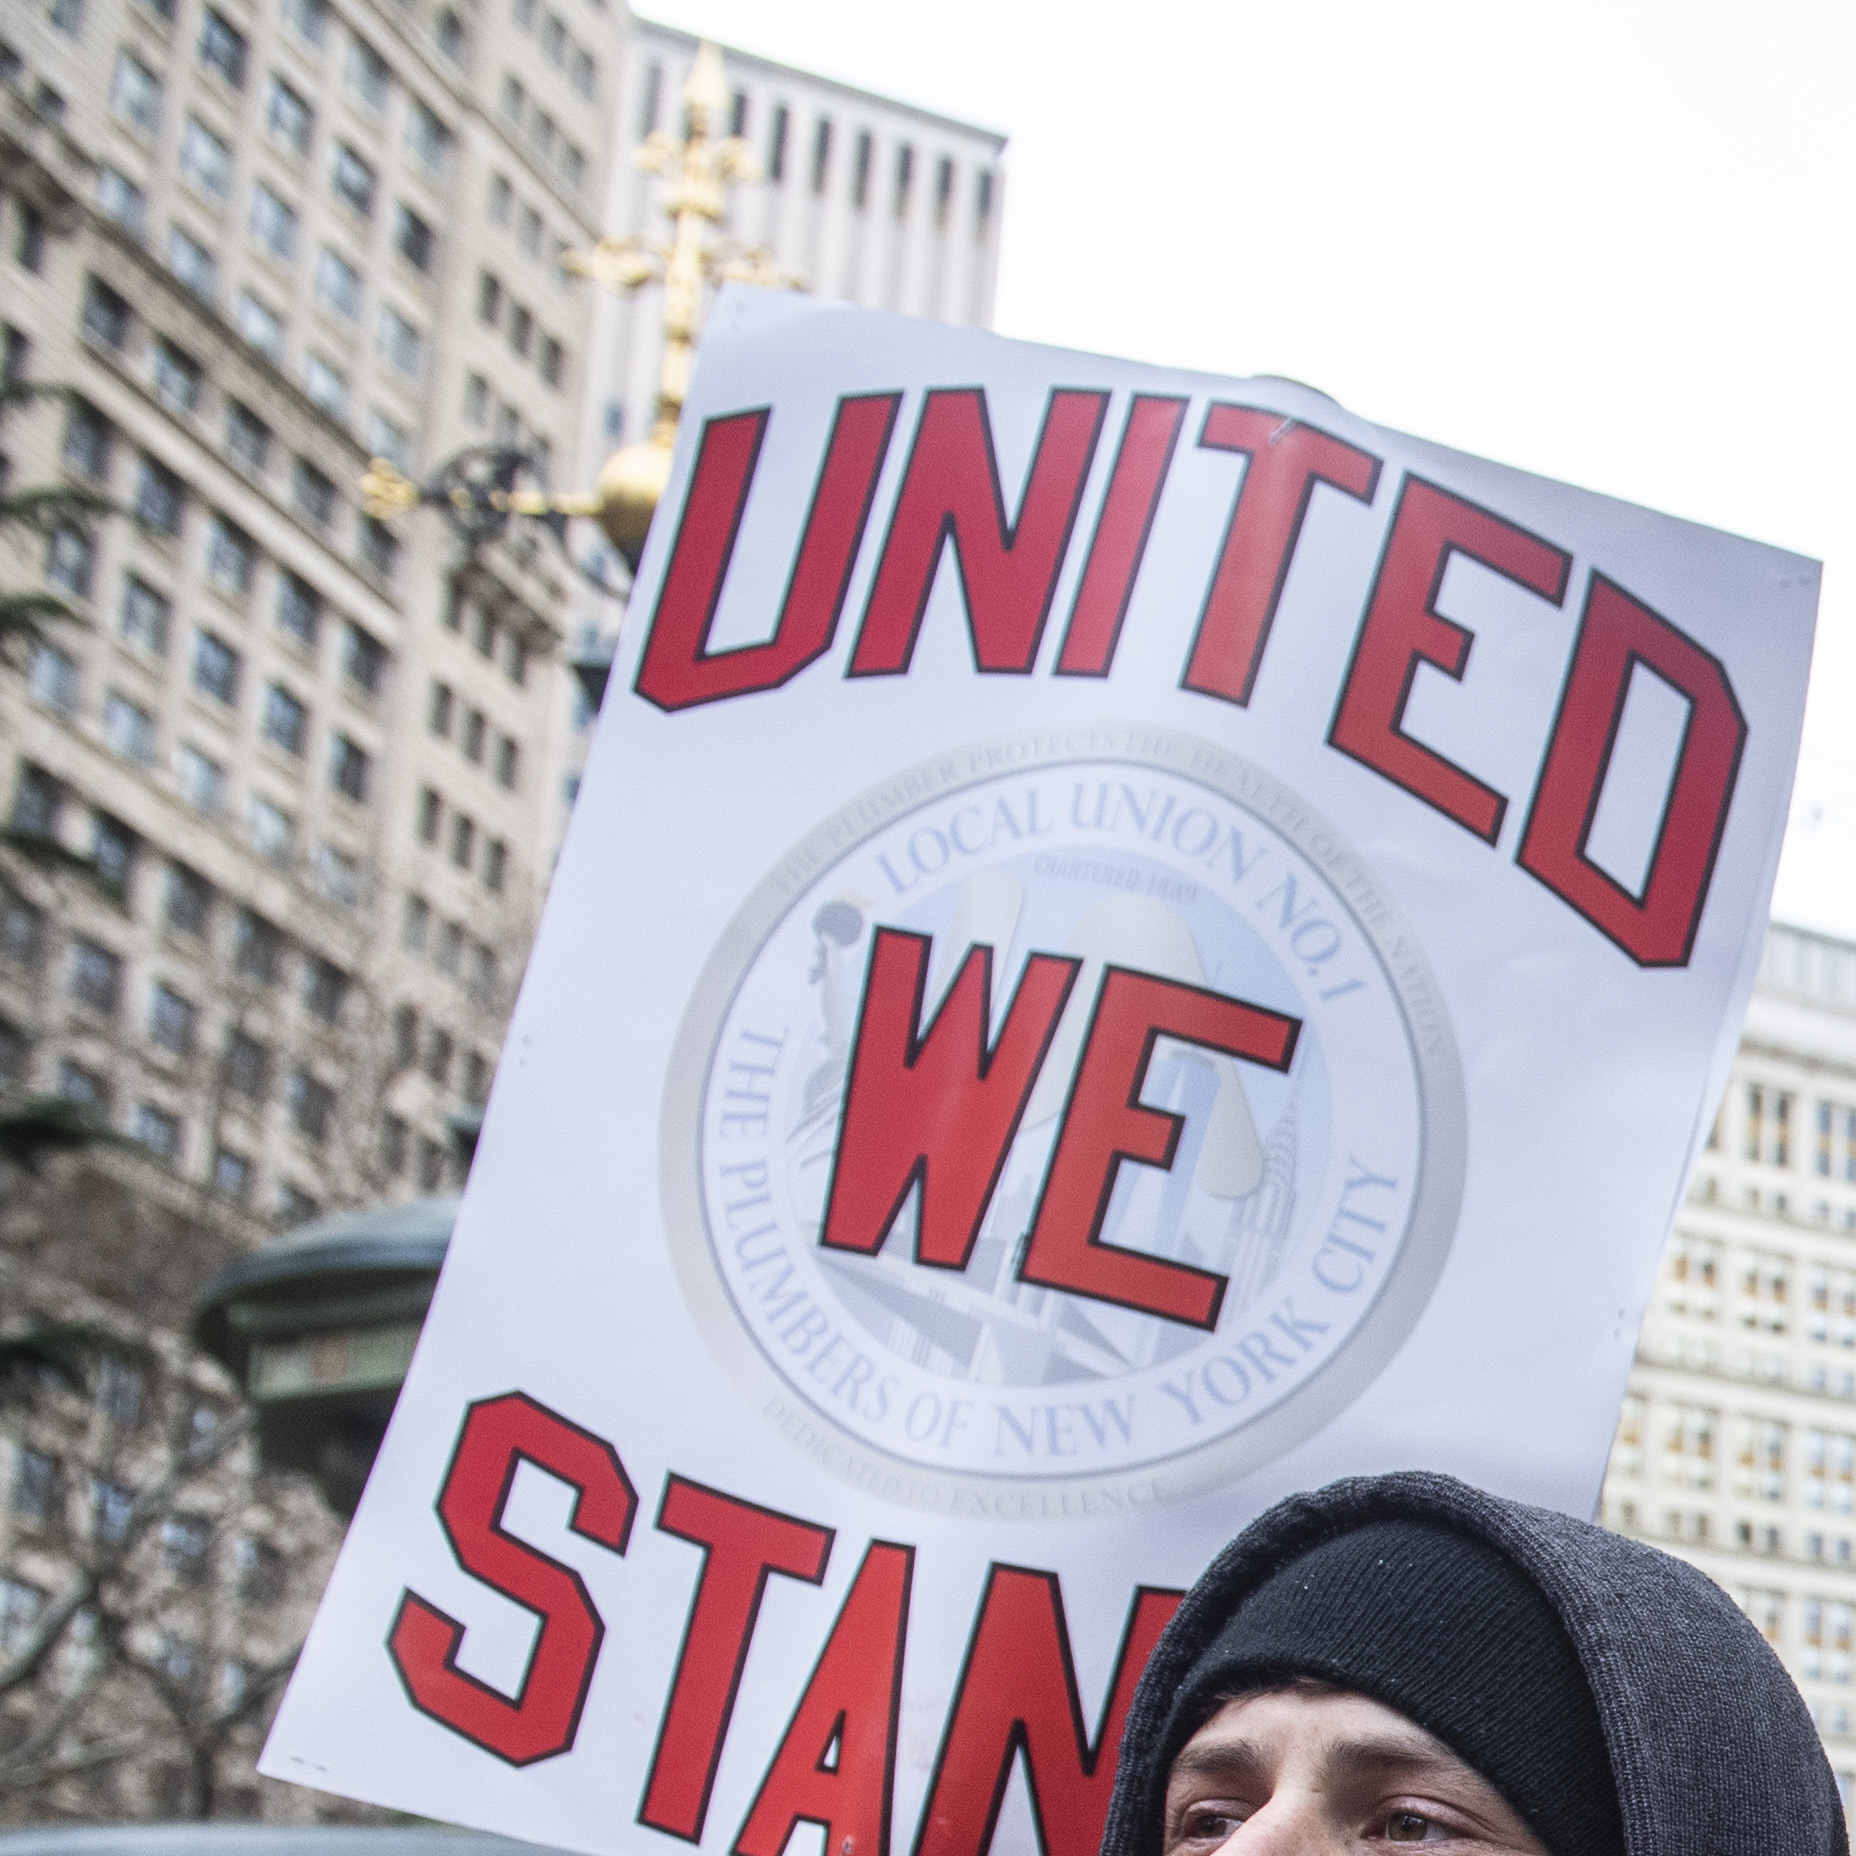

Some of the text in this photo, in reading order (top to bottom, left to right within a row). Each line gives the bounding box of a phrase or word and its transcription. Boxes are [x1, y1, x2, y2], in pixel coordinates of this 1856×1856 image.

[633, 387, 1749, 969] UNITED
[875, 787, 1054, 895] LOCAL
[1069, 780, 1269, 884] UNION
[968, 728, 1118, 773] PROTECTS
[718, 1025, 1400, 1458] THE PLUMBERS OF NEW YORK CITY
[818, 929, 1304, 1332] WE
